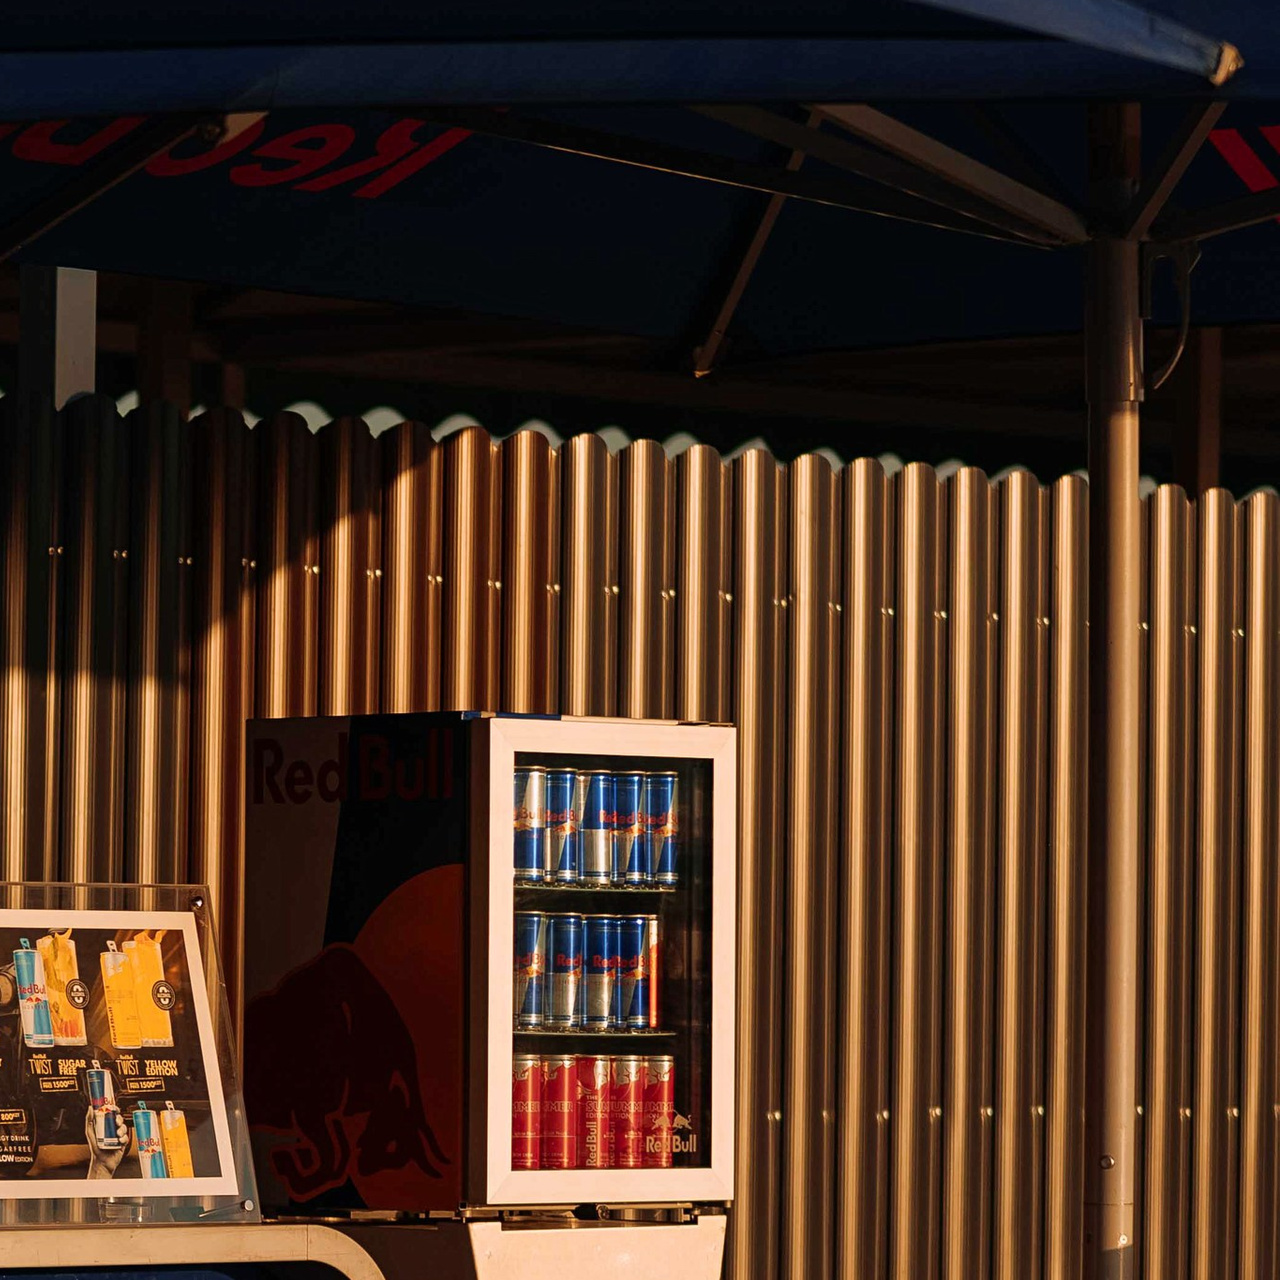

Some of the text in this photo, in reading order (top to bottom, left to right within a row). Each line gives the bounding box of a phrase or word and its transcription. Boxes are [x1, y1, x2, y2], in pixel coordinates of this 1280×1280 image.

[253, 728, 453, 804] Red Bull
[28, 1059, 87, 1074] TWIST SUGAR
[59, 1067, 77, 1075] FREE
[115, 1060, 177, 1075] TWIST YELLOW
[146, 1067, 179, 1076] EDITION
[586, 1121, 597, 1166] Red Bull
[646, 1134, 697, 1153] Red Bull
